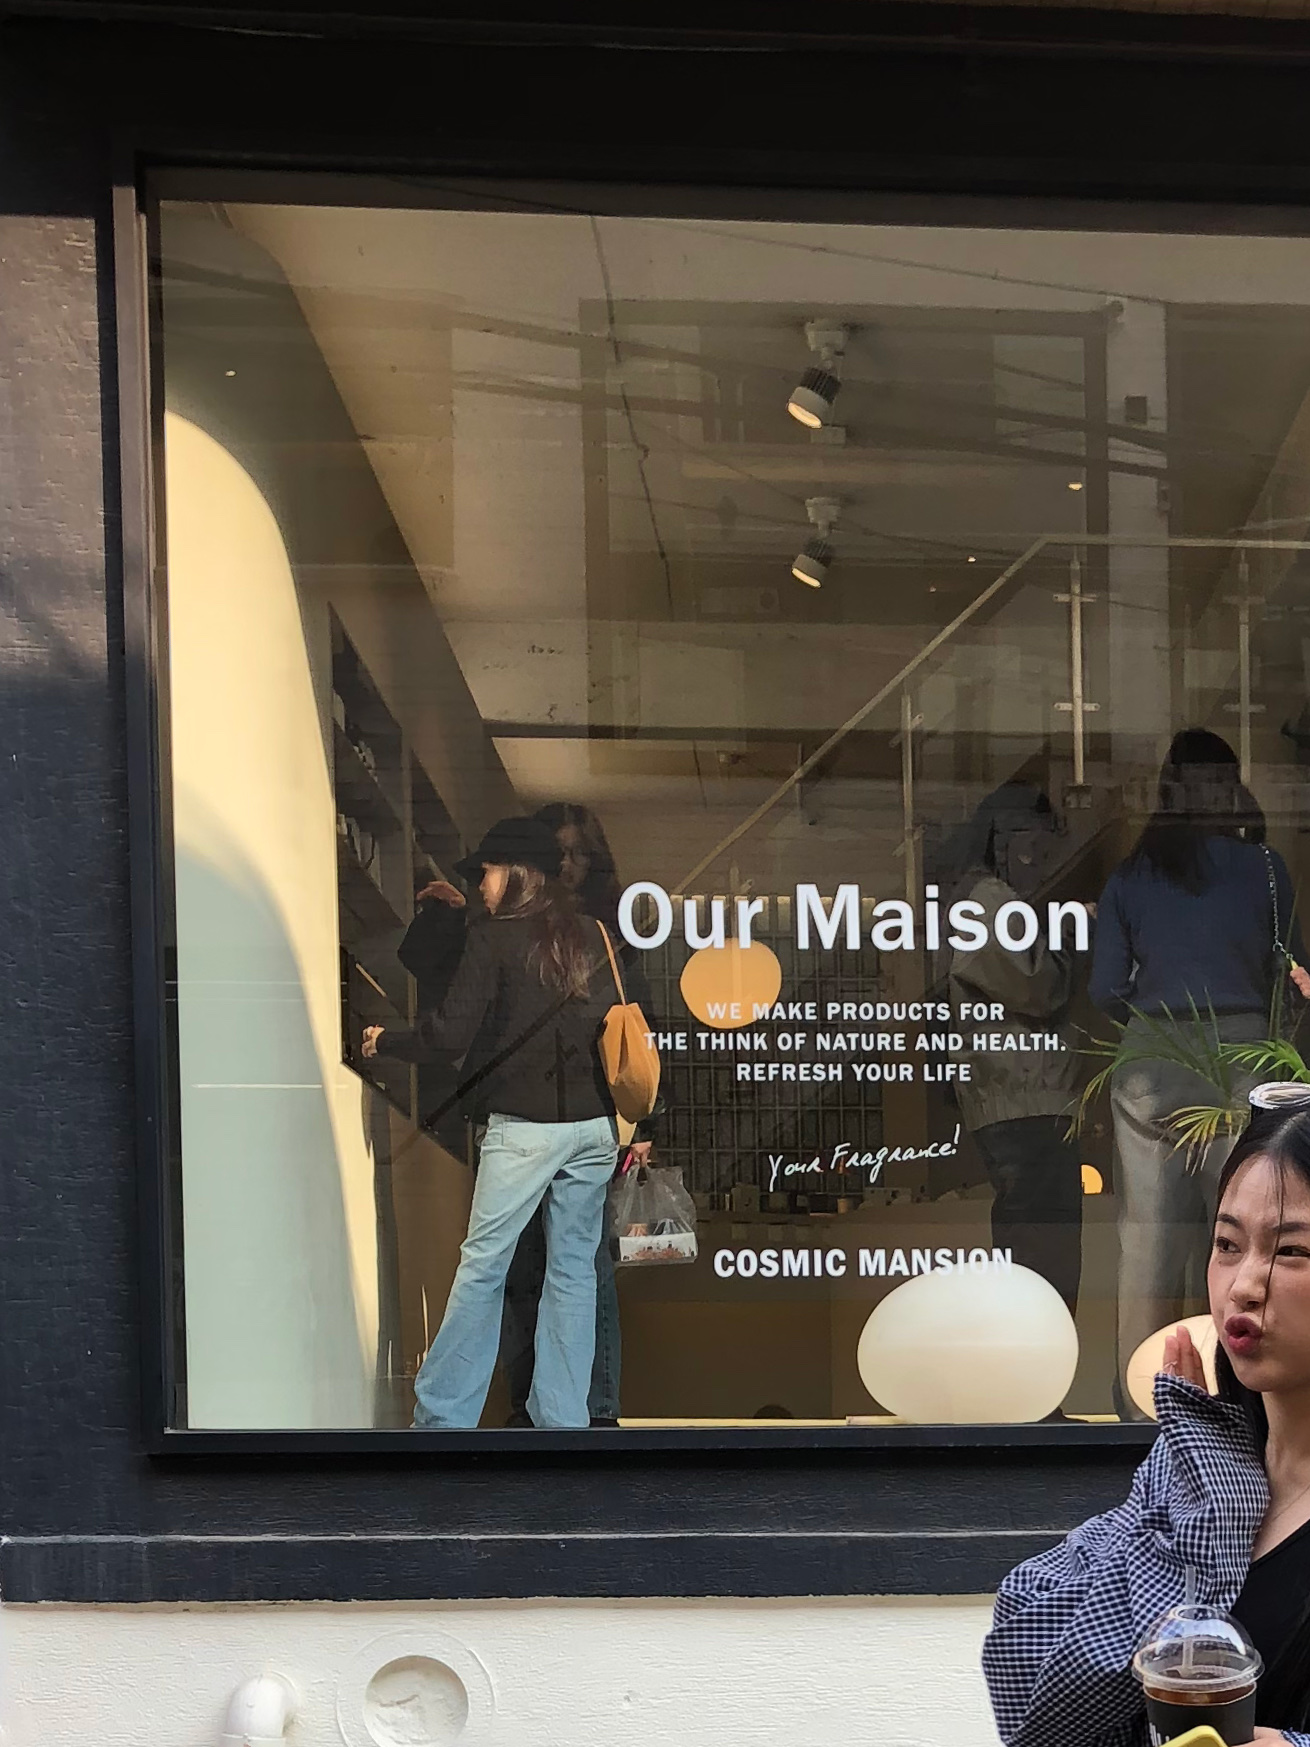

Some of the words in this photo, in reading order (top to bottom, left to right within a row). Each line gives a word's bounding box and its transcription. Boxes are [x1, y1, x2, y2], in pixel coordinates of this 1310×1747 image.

[617, 880, 763, 952] Our
[796, 883, 1089, 952] Maison
[706, 1002, 742, 1019] WE
[752, 1002, 818, 1020] MAKE
[827, 1002, 950, 1020] PRODUCTS
[960, 1003, 1005, 1020] FOR
[643, 1032, 688, 1051] THE
[696, 1032, 768, 1051] THINK
[777, 1032, 807, 1051] OF
[816, 1033, 906, 1051] NATURE
[914, 1033, 963, 1051] AND
[973, 1033, 1066, 1051] HEALTH.
[736, 1063, 843, 1081] REFRESH
[852, 1063, 914, 1081] YOUR
[923, 1063, 972, 1081] LIFE
[768, 1154, 825, 1193] Your
[830, 1123, 961, 1184] Fragrance!
[713, 1248, 847, 1278] COSMIC
[858, 1247, 1012, 1277] MANSION
